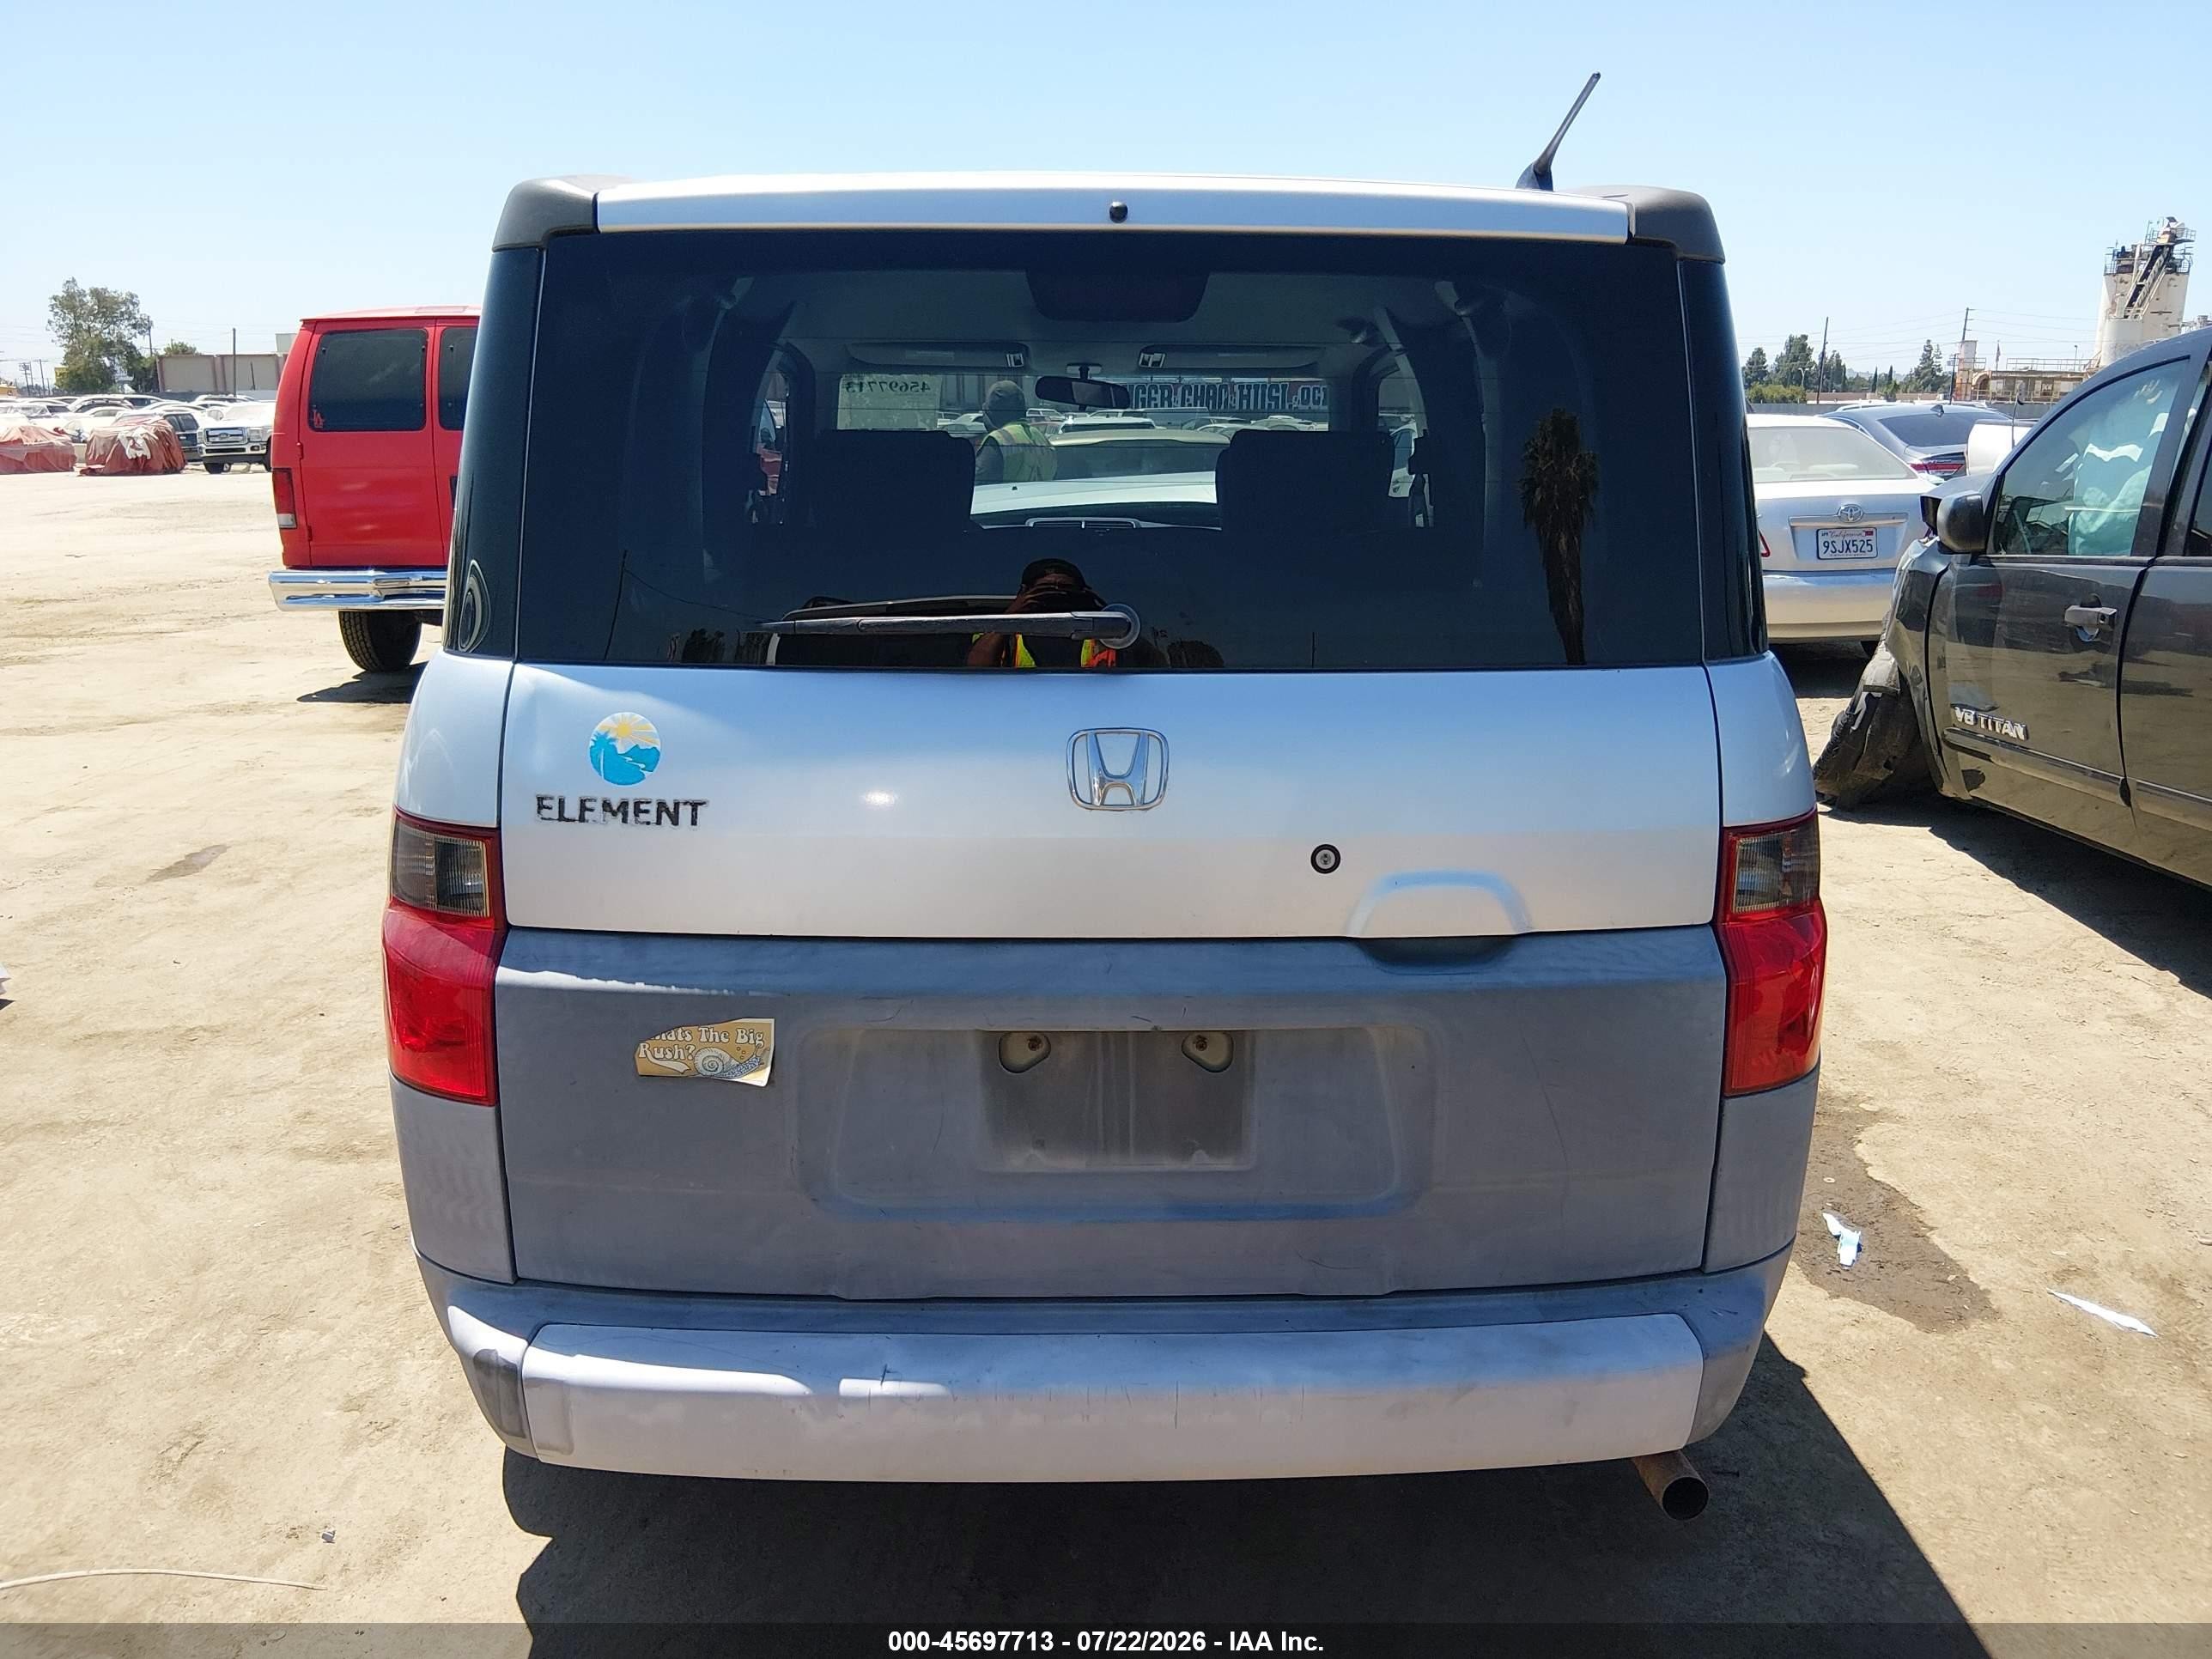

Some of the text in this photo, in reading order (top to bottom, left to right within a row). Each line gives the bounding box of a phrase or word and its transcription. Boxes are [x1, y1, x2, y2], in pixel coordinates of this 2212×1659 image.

[1822, 538, 1874, 555] 9SJX525
[1954, 706, 2027, 741] V8 TITAN
[536, 794, 708, 827] ELEMENT
[698, 1027, 730, 1043] The
[735, 1028, 764, 1048] Big
[638, 1042, 696, 1060] Rush?
